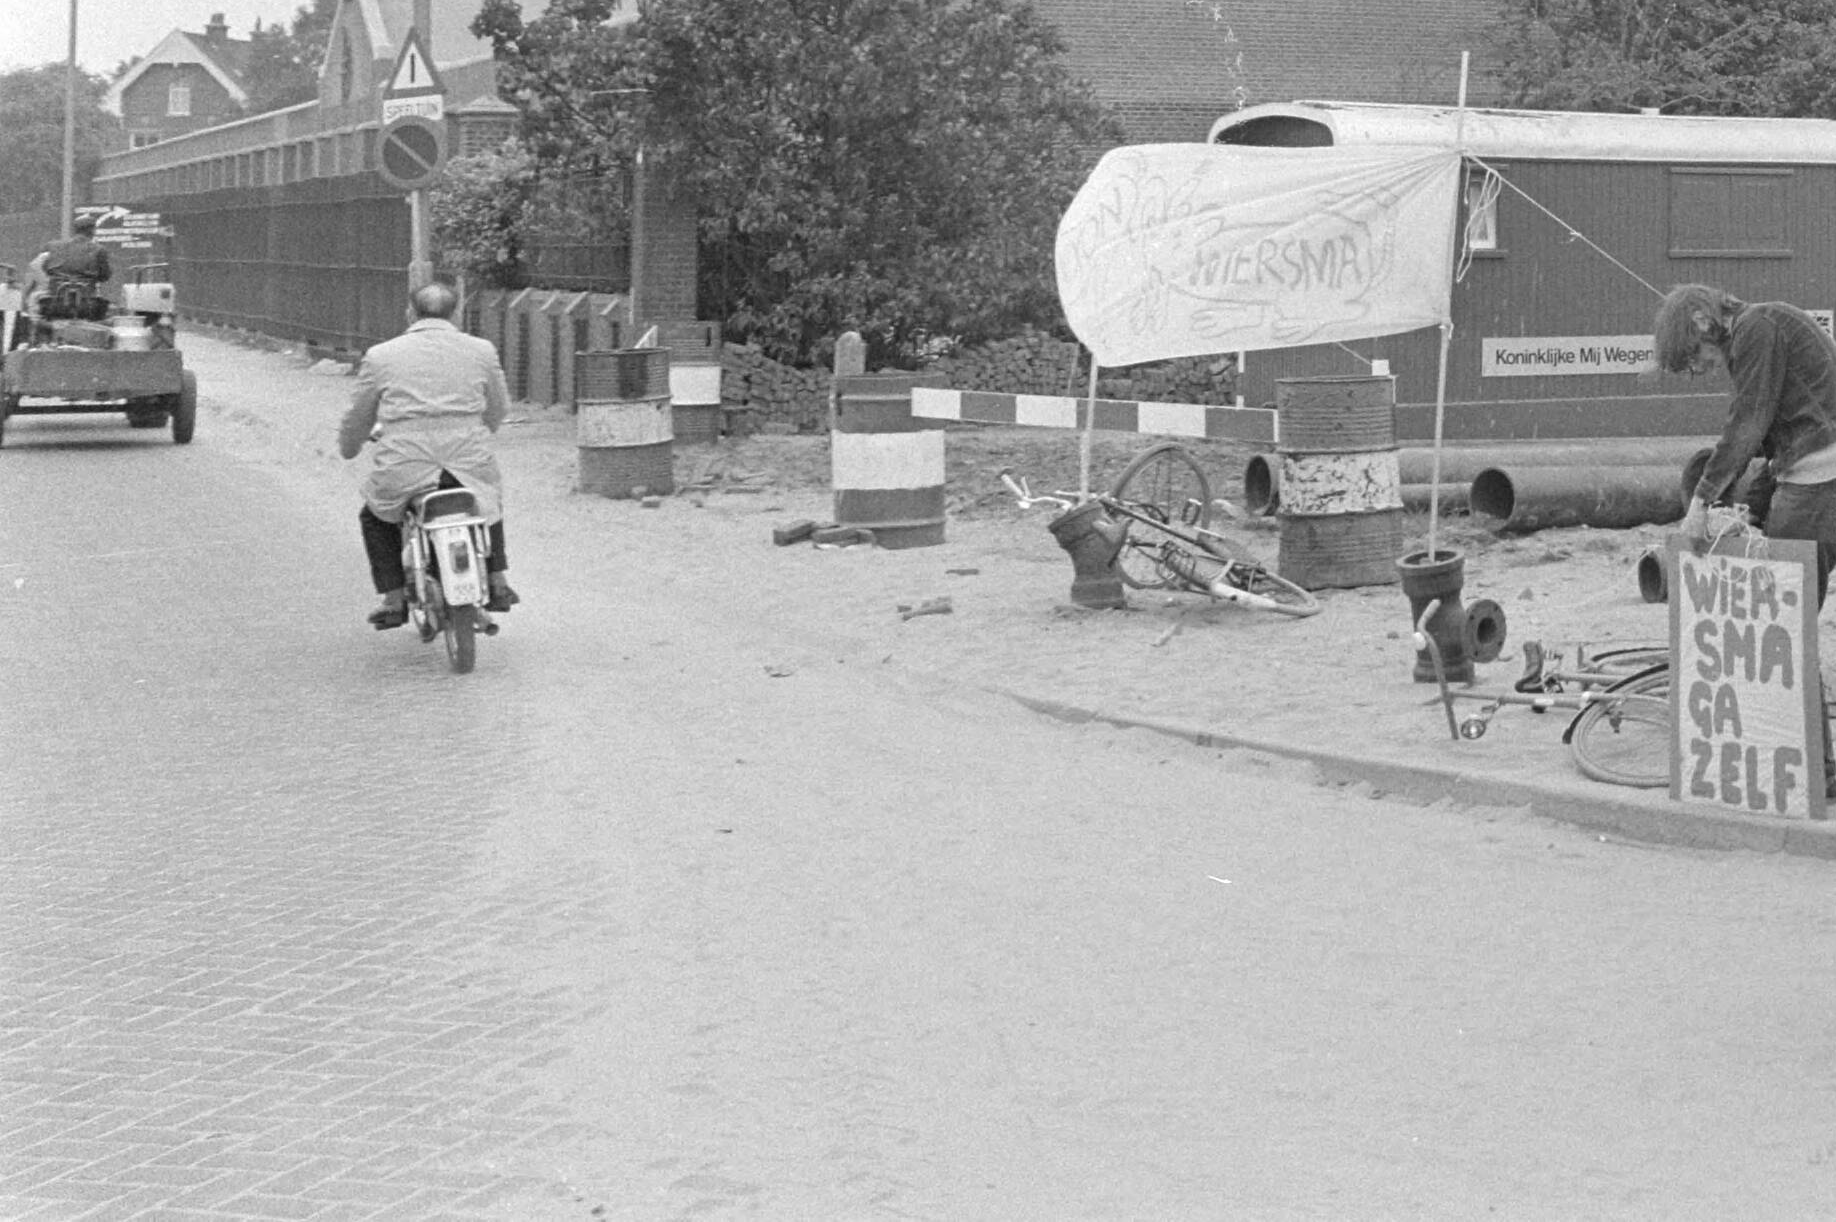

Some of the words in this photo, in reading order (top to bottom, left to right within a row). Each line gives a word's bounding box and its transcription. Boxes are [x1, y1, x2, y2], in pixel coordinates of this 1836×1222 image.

[1188, 233, 1363, 291] WIERSMA
[1495, 346, 1576, 367] Koninklijke
[1580, 346, 1601, 366] Mij
[1694, 618, 1794, 690] SMA
[1690, 737, 1803, 814] ZELF
